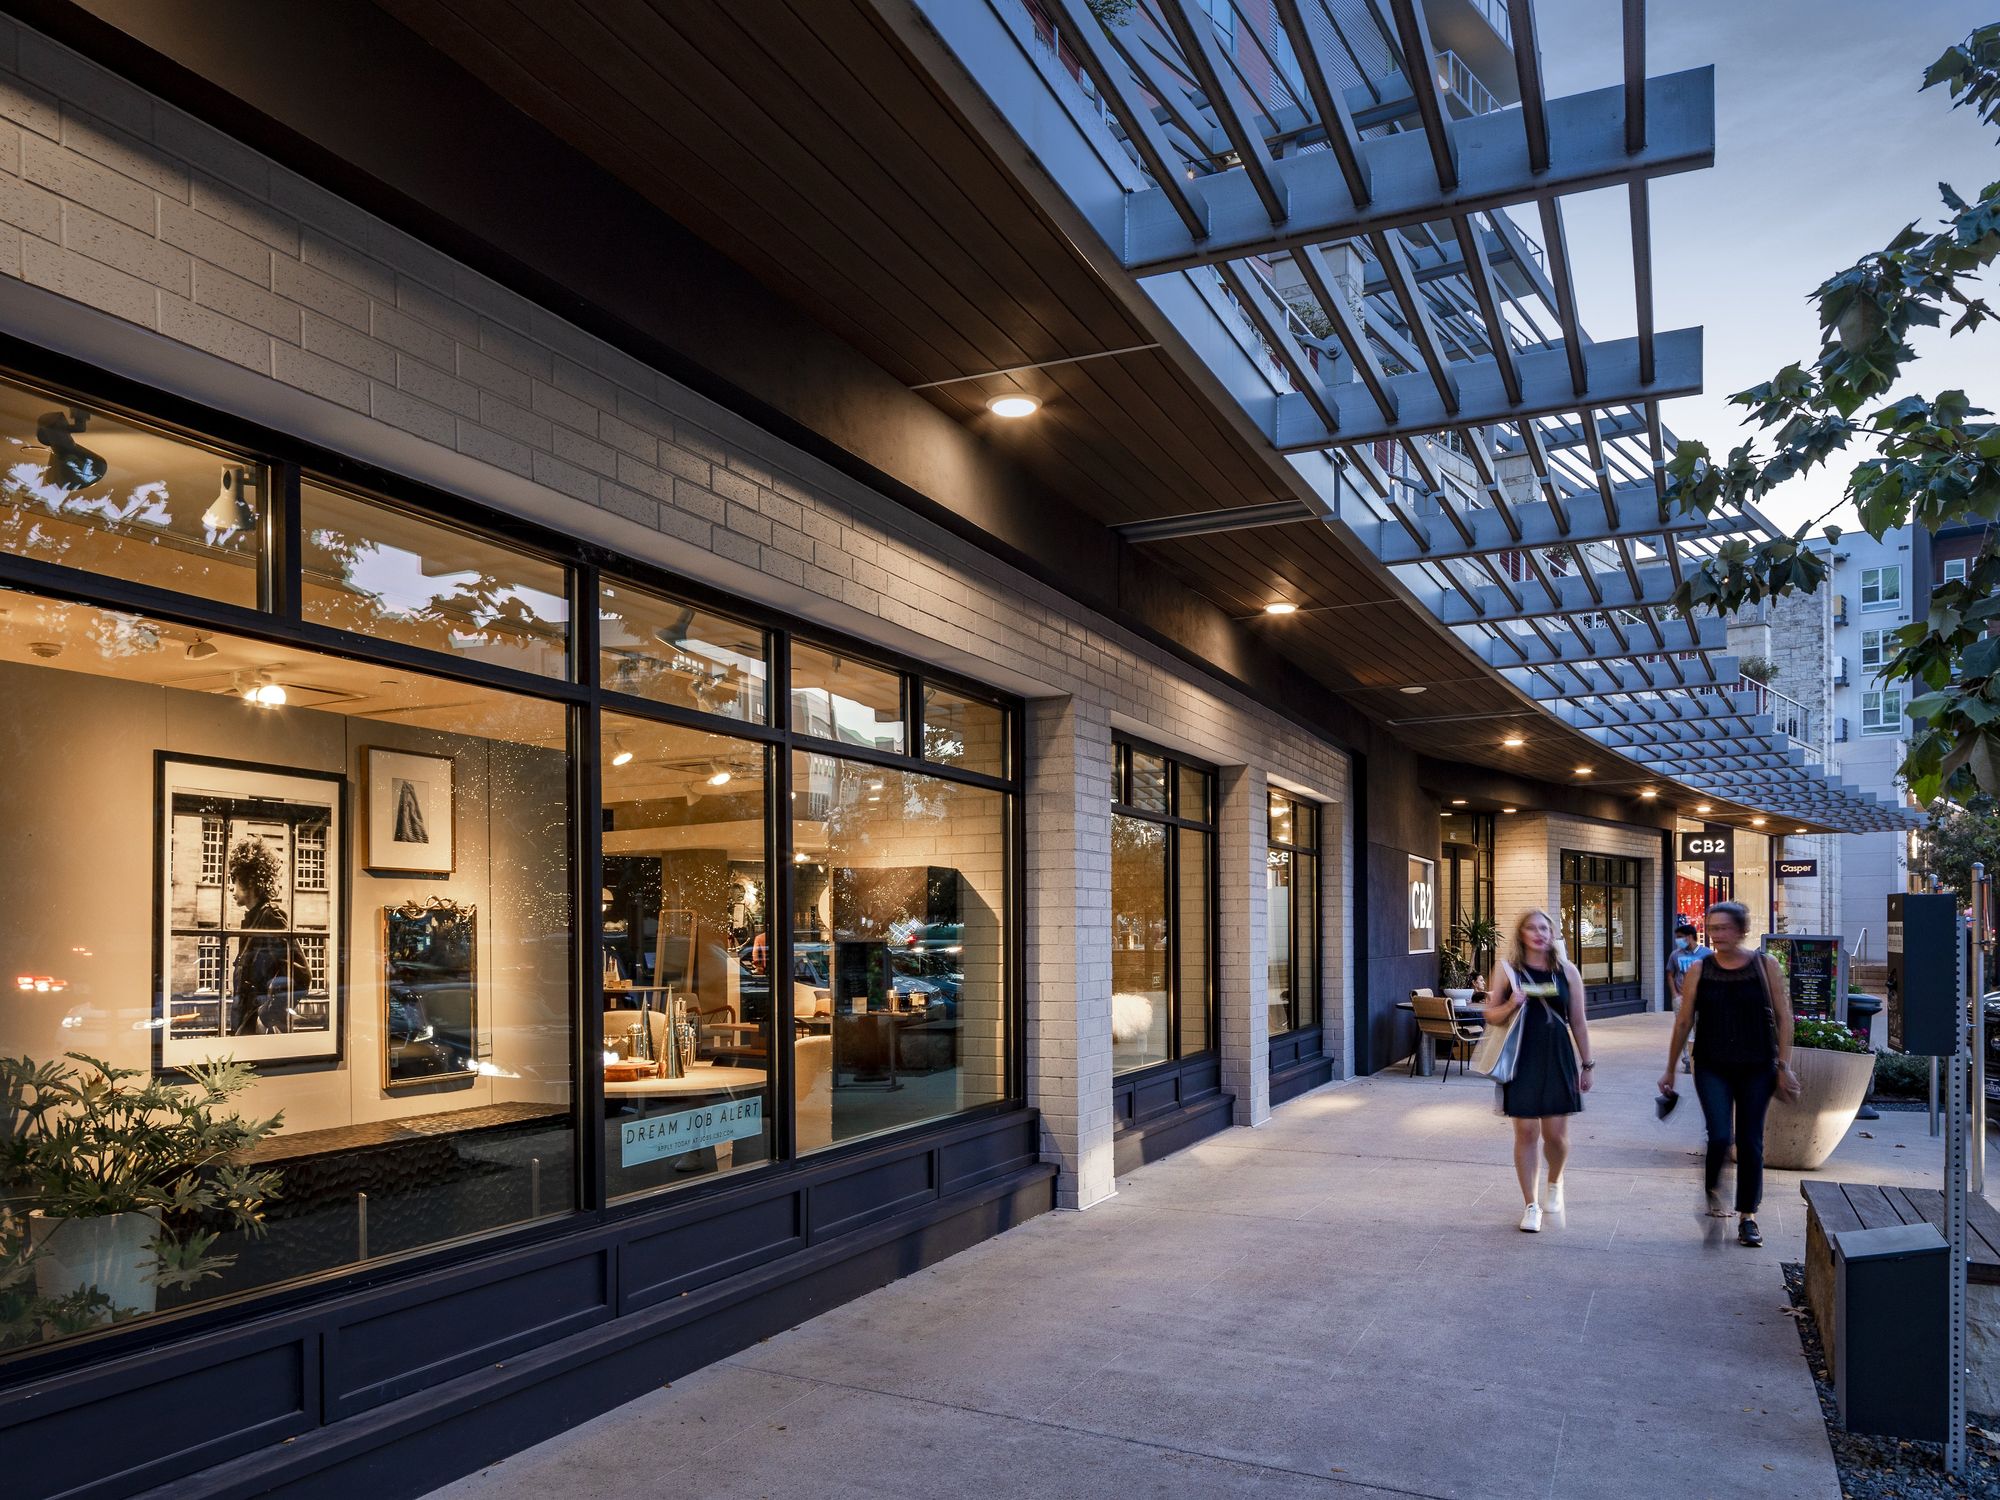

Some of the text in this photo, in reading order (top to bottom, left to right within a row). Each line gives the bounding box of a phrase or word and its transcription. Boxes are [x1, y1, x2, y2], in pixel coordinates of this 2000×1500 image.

[1689, 839, 1726, 854] CB2
[1780, 864, 1812, 874] Casper
[1412, 880, 1432, 929] CB2
[626, 1102, 759, 1145] DREAM JOB ALERT
